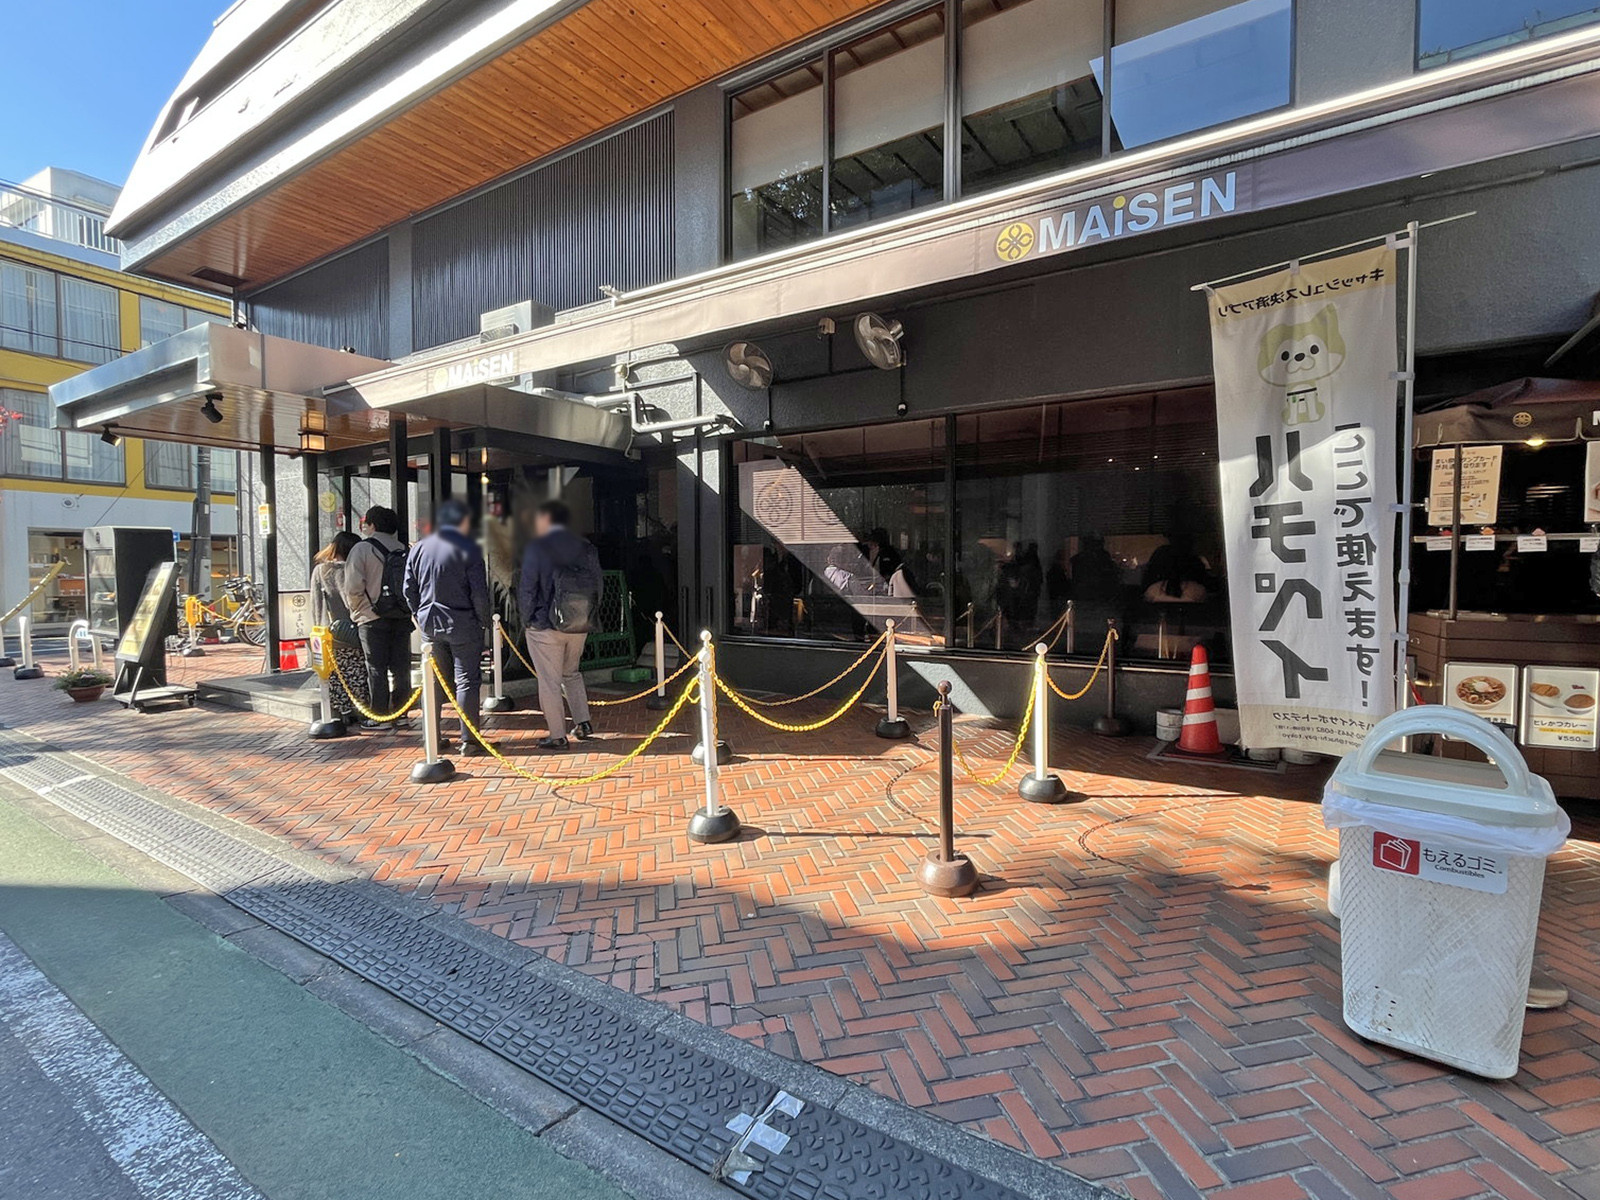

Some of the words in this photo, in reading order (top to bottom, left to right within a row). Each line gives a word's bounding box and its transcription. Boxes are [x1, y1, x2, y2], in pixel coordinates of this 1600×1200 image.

[1038, 171, 1237, 253] MAiSEN
[448, 351, 514, 387] MAiSEN
[1533, 720, 1587, 728] ヒレかつカレー
[1422, 847, 1497, 874] もえるゴミ
[1434, 864, 1485, 879] Combustibles
